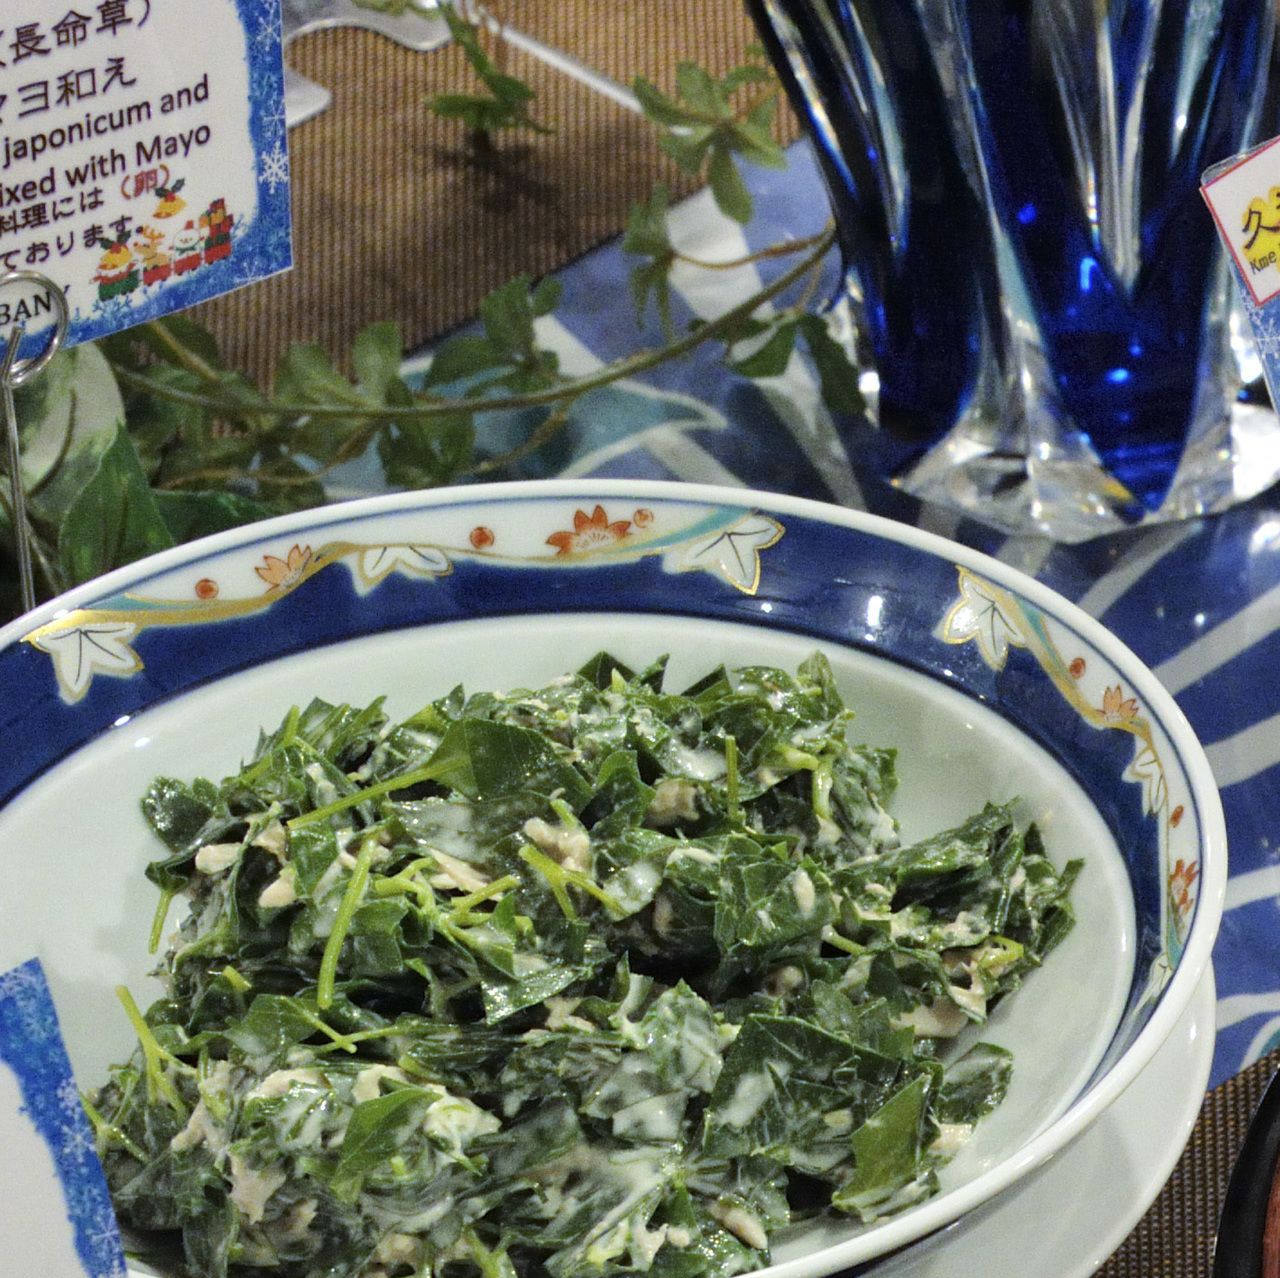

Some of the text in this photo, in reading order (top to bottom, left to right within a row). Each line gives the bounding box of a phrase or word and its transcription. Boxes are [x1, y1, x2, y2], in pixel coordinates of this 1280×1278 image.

[0, 57, 137, 122] ヨ和え
[3, 73, 209, 170] japonicum and
[65, 148, 126, 188] with
[135, 125, 211, 166] Mayo
